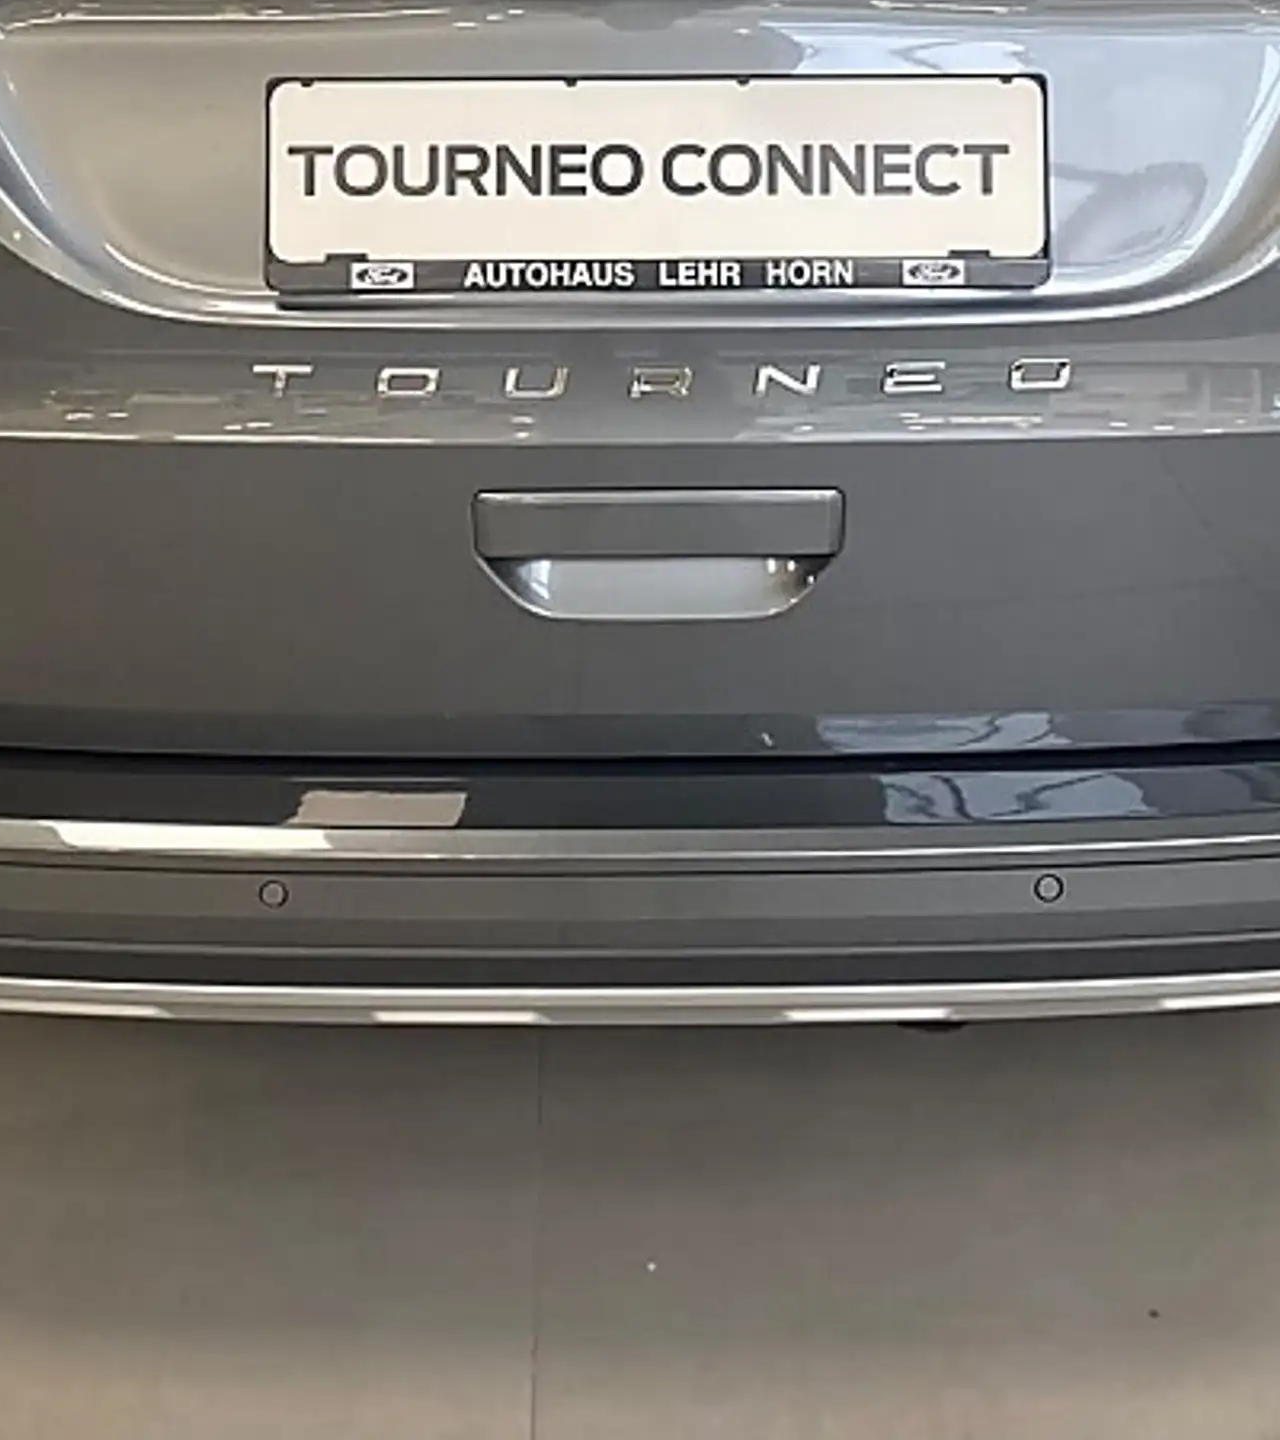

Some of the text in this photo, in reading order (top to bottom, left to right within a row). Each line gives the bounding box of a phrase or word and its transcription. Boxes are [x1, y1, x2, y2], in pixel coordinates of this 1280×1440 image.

[287, 143, 1010, 197] TOURNEO CONNECT
[463, 261, 855, 287] AUTOHAUS LEHR HORN
[252, 359, 1073, 398] TOURNEO
